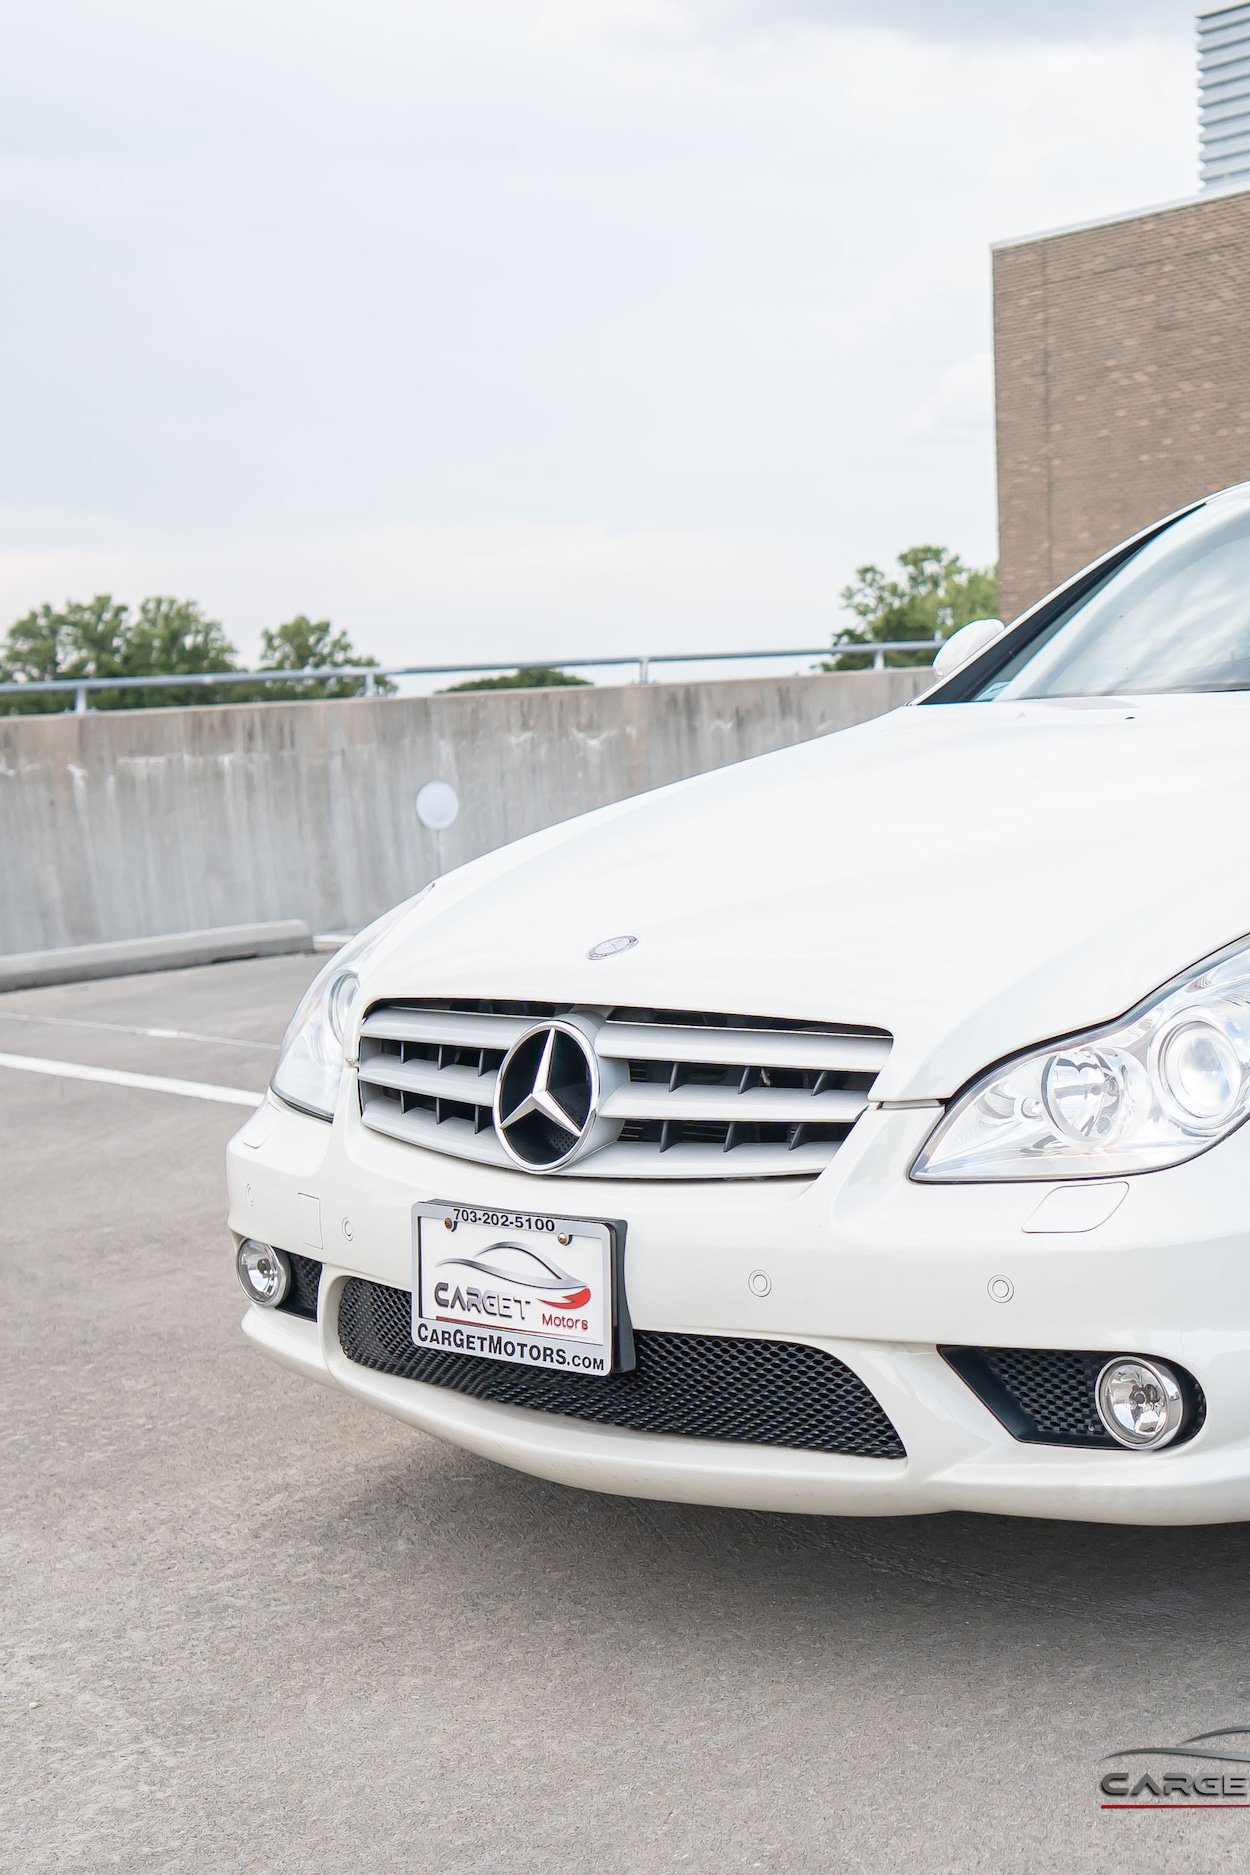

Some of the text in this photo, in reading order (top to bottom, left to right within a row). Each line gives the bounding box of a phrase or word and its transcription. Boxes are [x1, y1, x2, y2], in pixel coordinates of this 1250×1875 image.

[453, 1208, 556, 1232] 703-202-5100
[434, 1281, 531, 1320] CARGET
[542, 1313, 589, 1332] Motors
